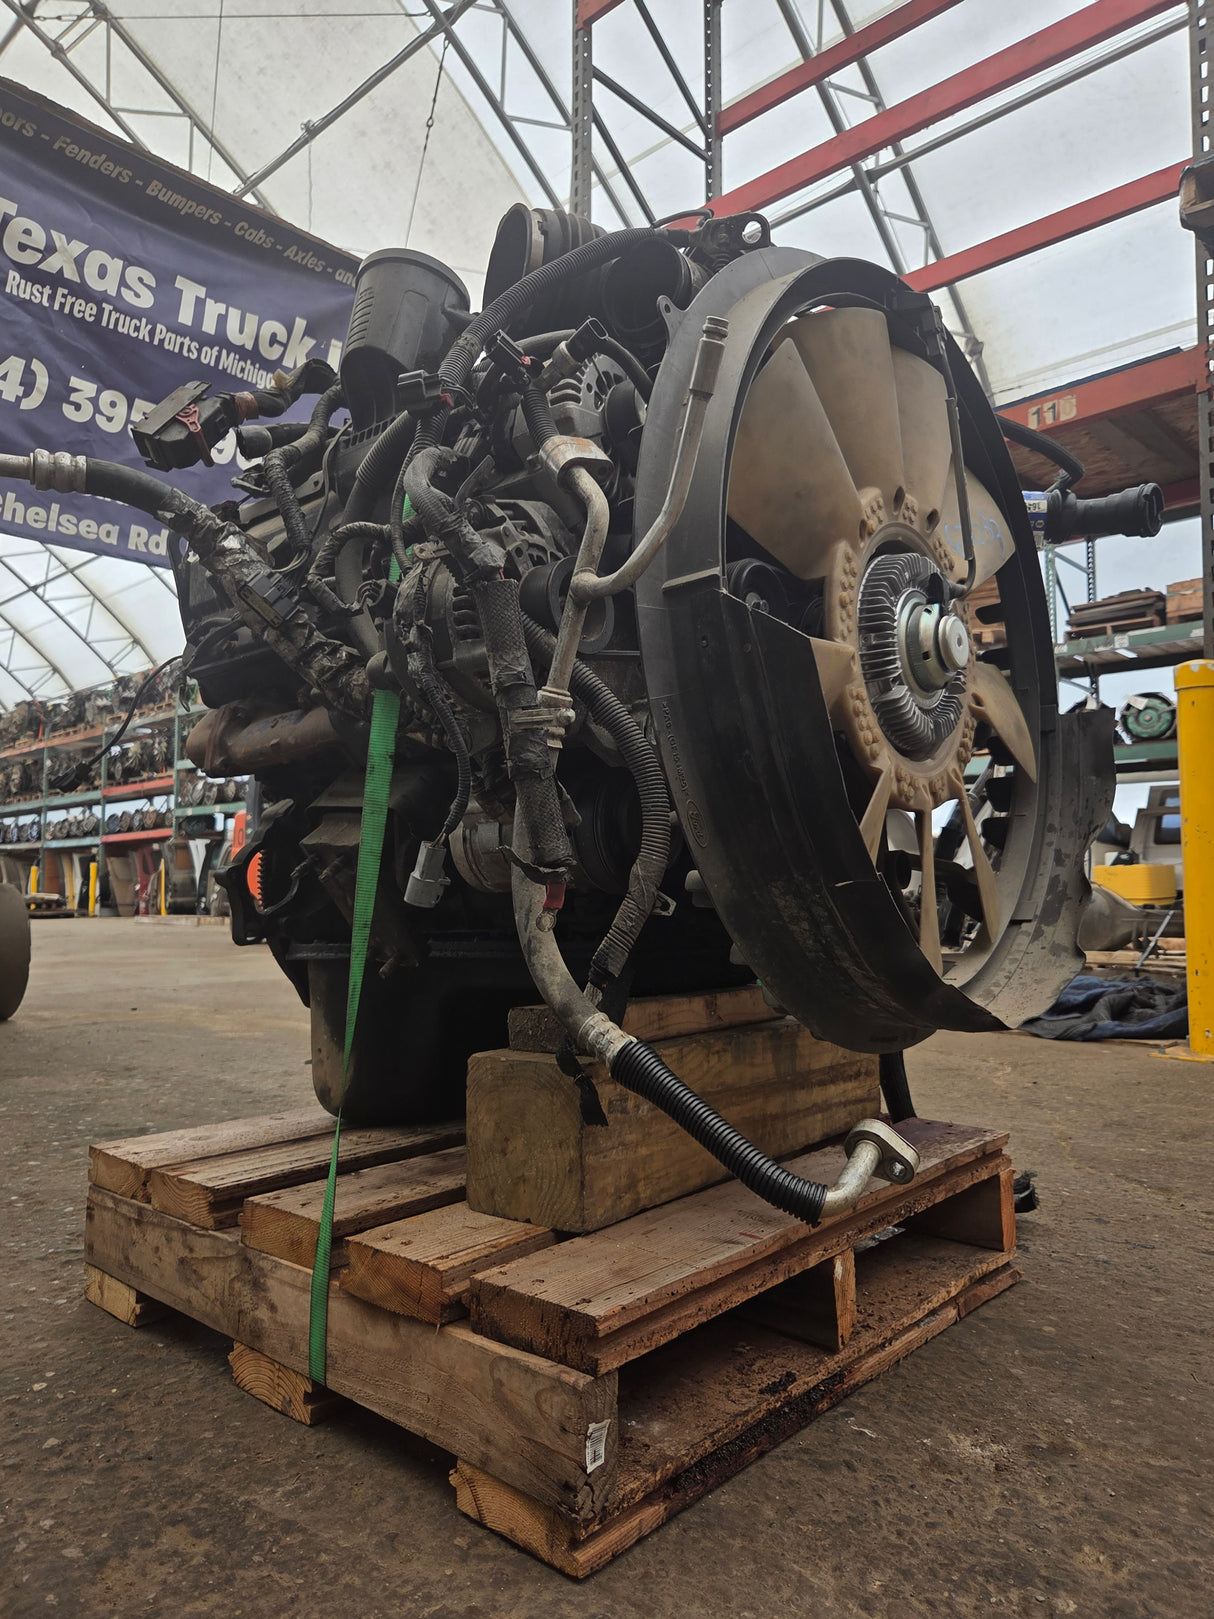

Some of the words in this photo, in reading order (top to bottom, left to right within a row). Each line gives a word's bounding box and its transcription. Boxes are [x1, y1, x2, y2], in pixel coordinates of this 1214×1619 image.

[0, 108, 37, 137] ors
[53, 136, 132, 183] Fenders
[146, 180, 222, 225] Bumpers
[234, 221, 274, 248] Cabs
[284, 245, 326, 272] Axles
[5, 269, 52, 307] Rust
[53, 287, 97, 322] Free
[101, 302, 152, 342] Truck
[153, 323, 199, 360] Parts
[200, 345, 219, 367] of
[174, 275, 316, 369] Truck
[0, 491, 120, 546] helsea
[128, 524, 169, 556] Rd
